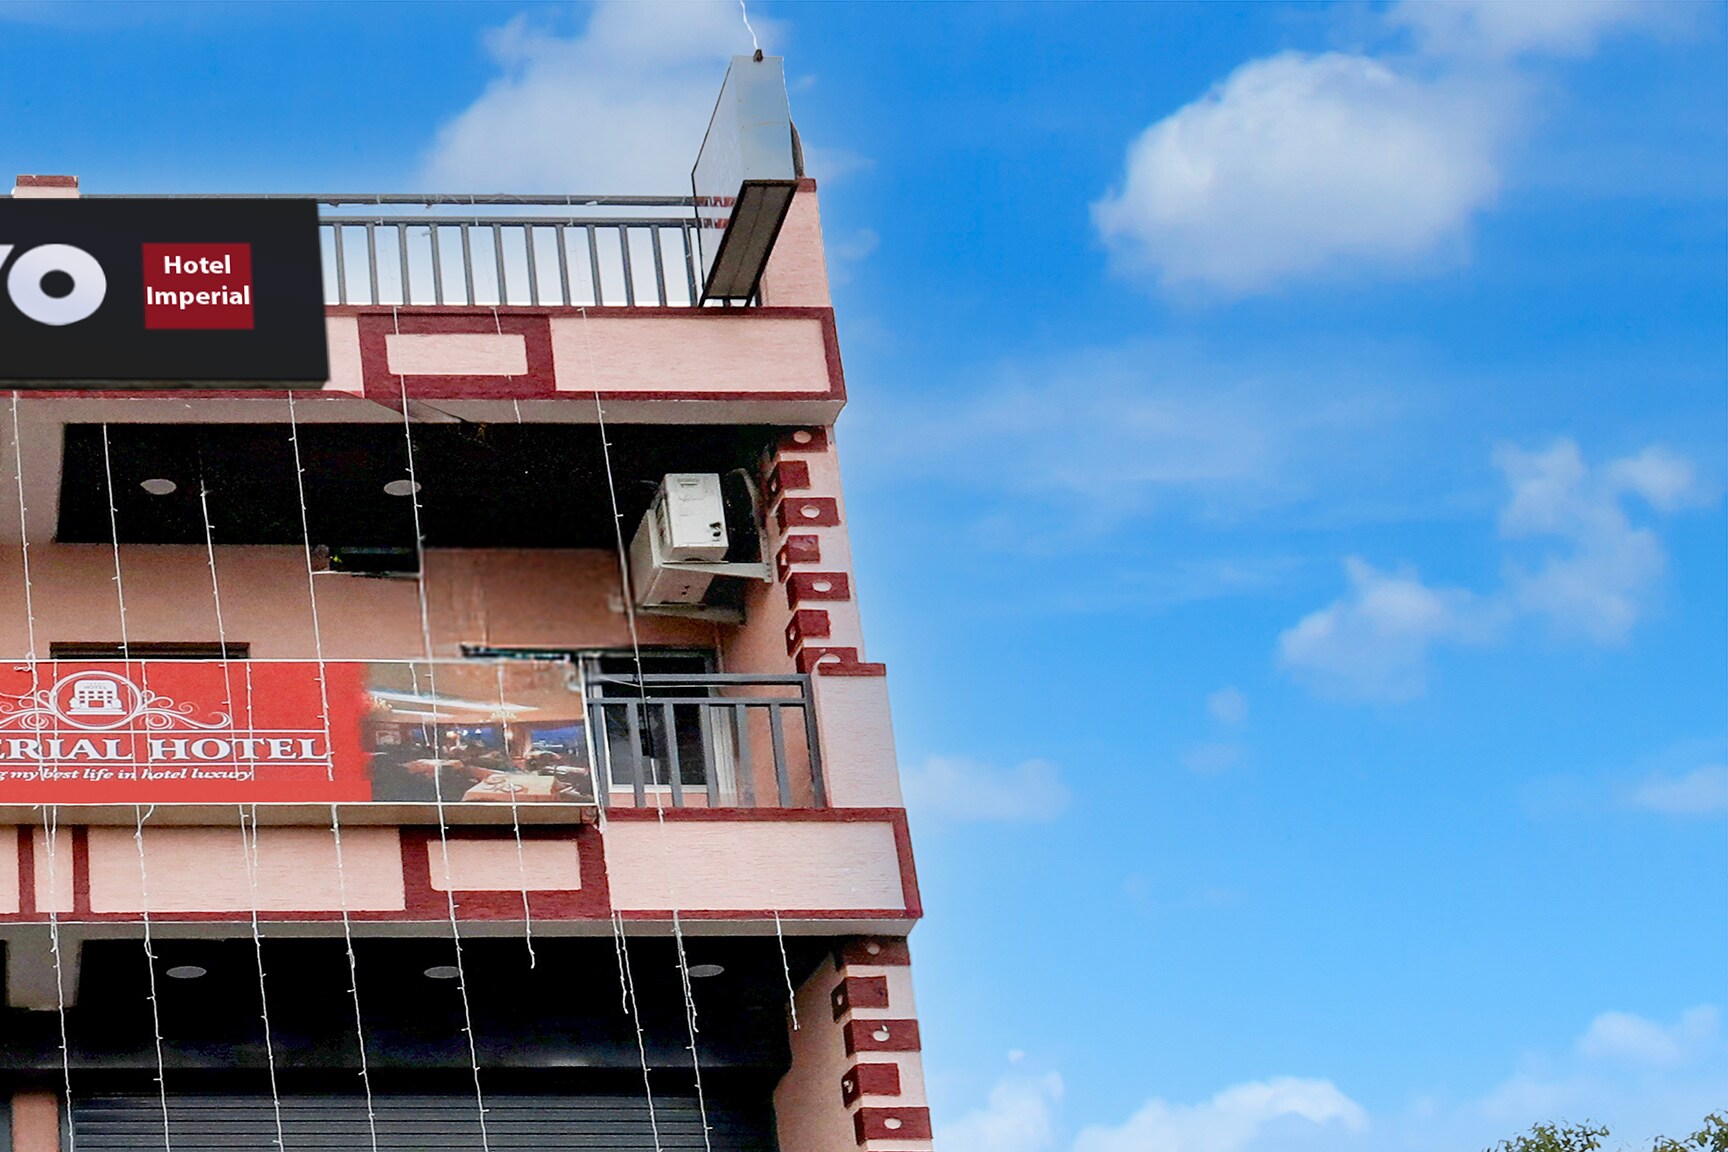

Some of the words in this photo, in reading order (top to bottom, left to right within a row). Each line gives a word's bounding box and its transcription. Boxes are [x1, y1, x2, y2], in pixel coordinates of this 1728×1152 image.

[163, 255, 232, 275] Hotel
[146, 285, 251, 310] Imperial
[149, 737, 328, 761] HOTEL
[10, 770, 40, 781] my
[42, 767, 80, 779] best
[83, 767, 114, 781] life
[118, 768, 136, 779] in
[141, 767, 187, 779] hotel
[191, 767, 251, 781] luxury
